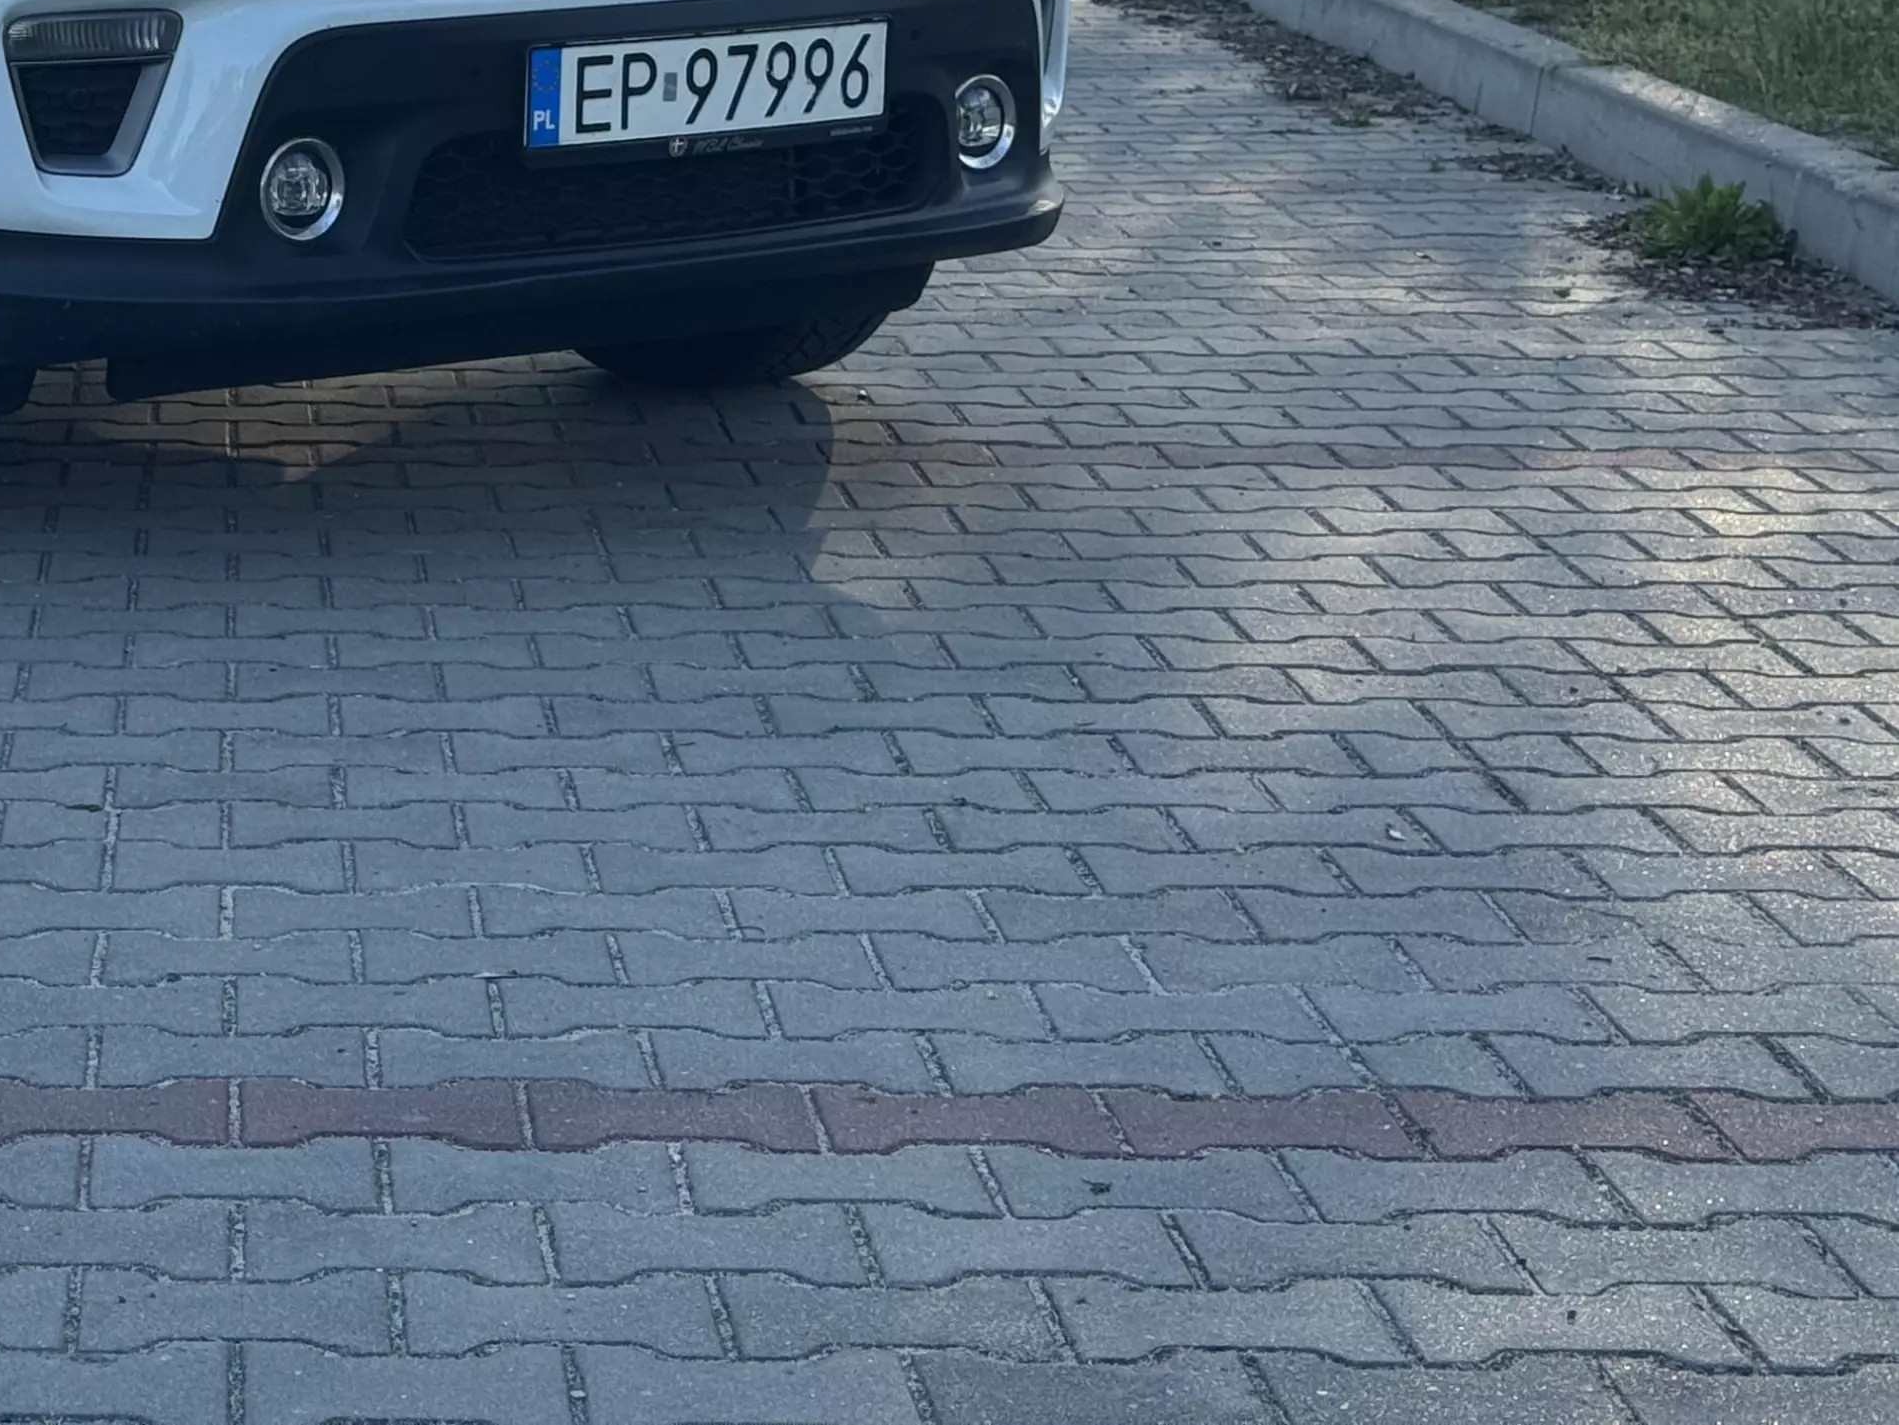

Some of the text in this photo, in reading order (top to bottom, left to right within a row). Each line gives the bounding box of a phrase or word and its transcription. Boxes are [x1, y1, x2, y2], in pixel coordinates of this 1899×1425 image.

[575, 33, 871, 134] EP 97996
[533, 109, 556, 131] PL
